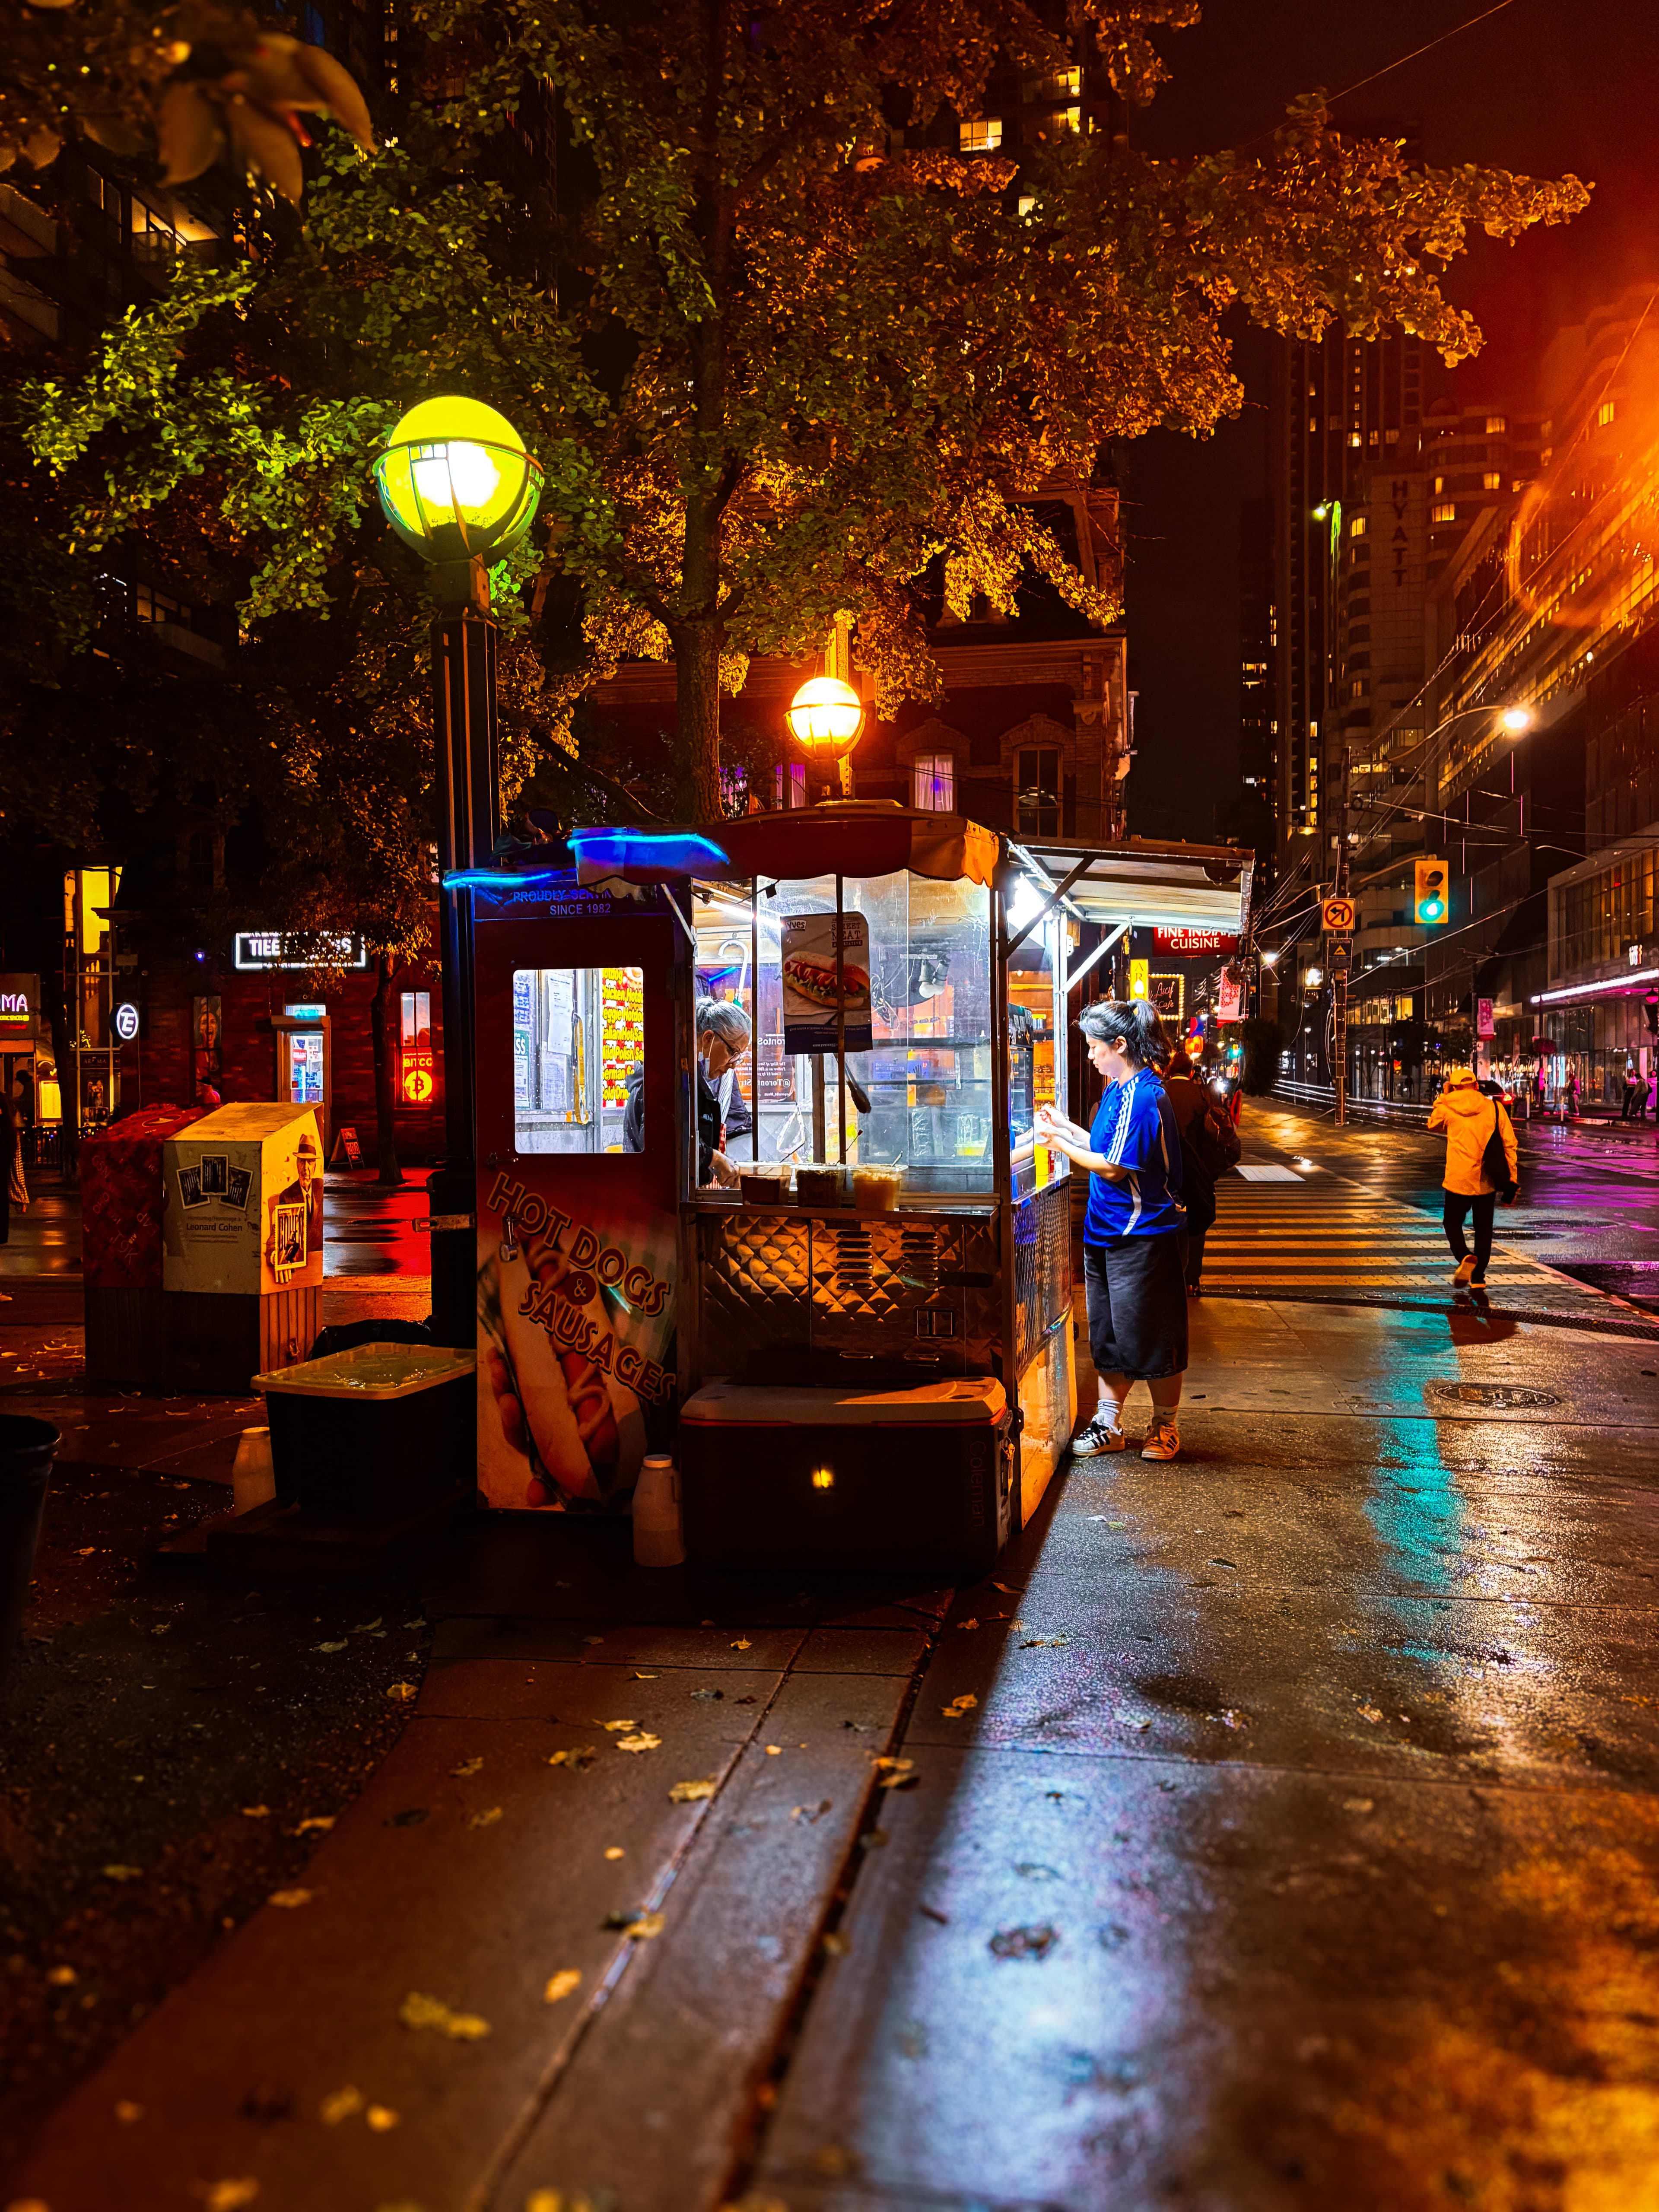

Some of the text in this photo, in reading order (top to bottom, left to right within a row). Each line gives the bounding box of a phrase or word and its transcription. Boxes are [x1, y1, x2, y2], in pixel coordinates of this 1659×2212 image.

[1392, 480, 1408, 587] HYATT
[549, 903, 611, 915] SINCE 1982
[1157, 927, 1185, 938] FINE
[1170, 937, 1220, 949] CUISINE
[615, 1045, 634, 1061] Polish
[186, 1223, 242, 1231] Leonard Cohen
[487, 1171, 671, 1317] HOT DOGS
[574, 1278, 587, 1297] &
[518, 1281, 676, 1406] SAUSAGES
